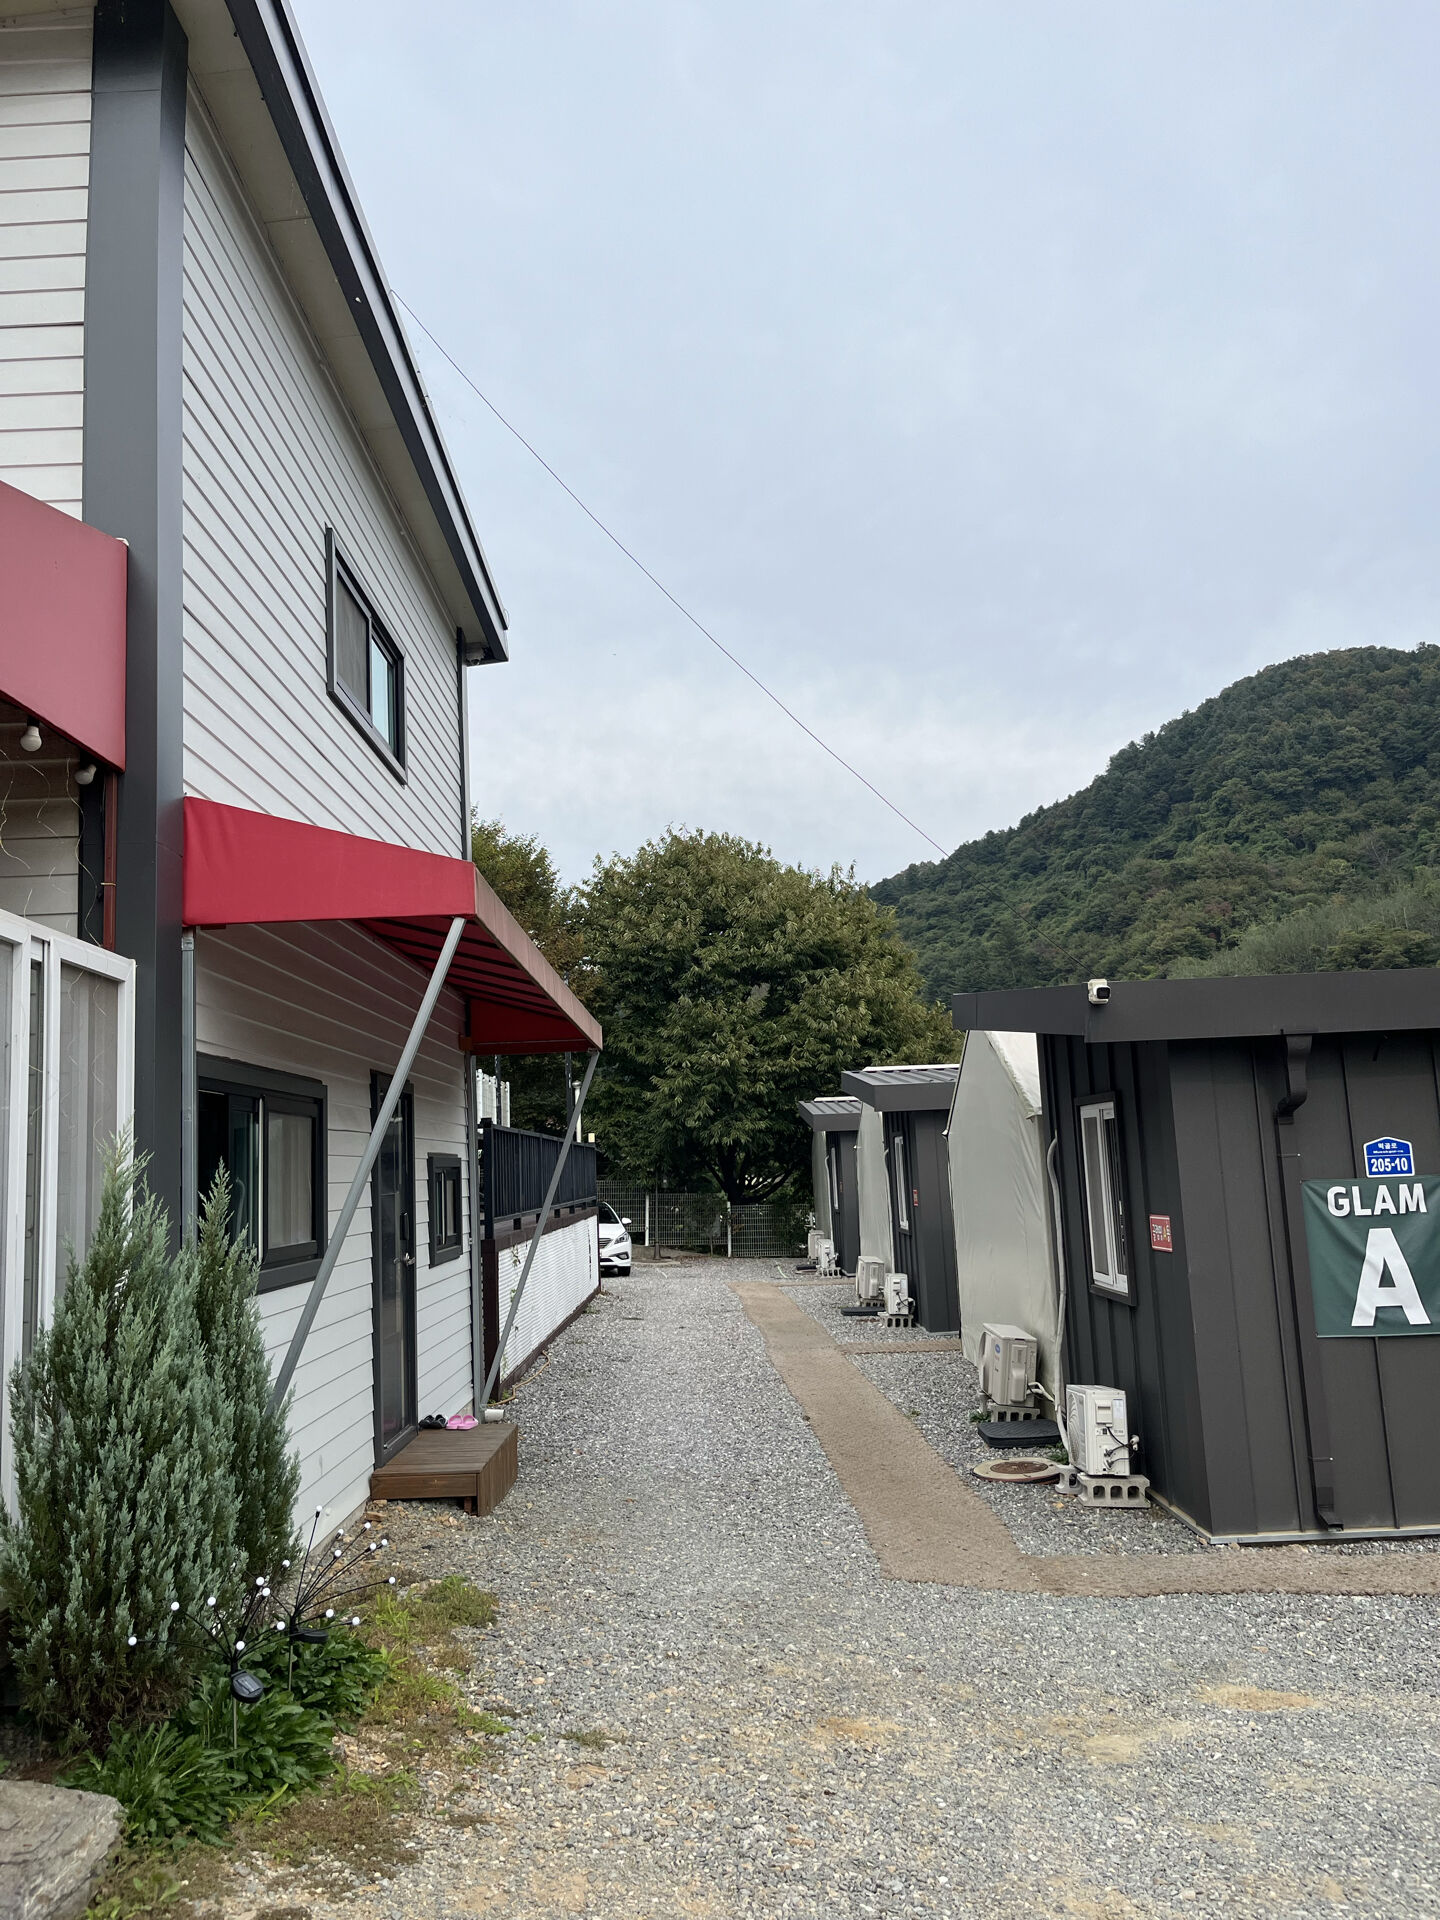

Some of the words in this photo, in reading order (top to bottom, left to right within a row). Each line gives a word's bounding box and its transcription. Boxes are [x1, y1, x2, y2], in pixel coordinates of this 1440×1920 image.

[1370, 1157, 1408, 1172] 205-10
[1327, 1183, 1428, 1217] GLAM
[1351, 1227, 1432, 1327] A
